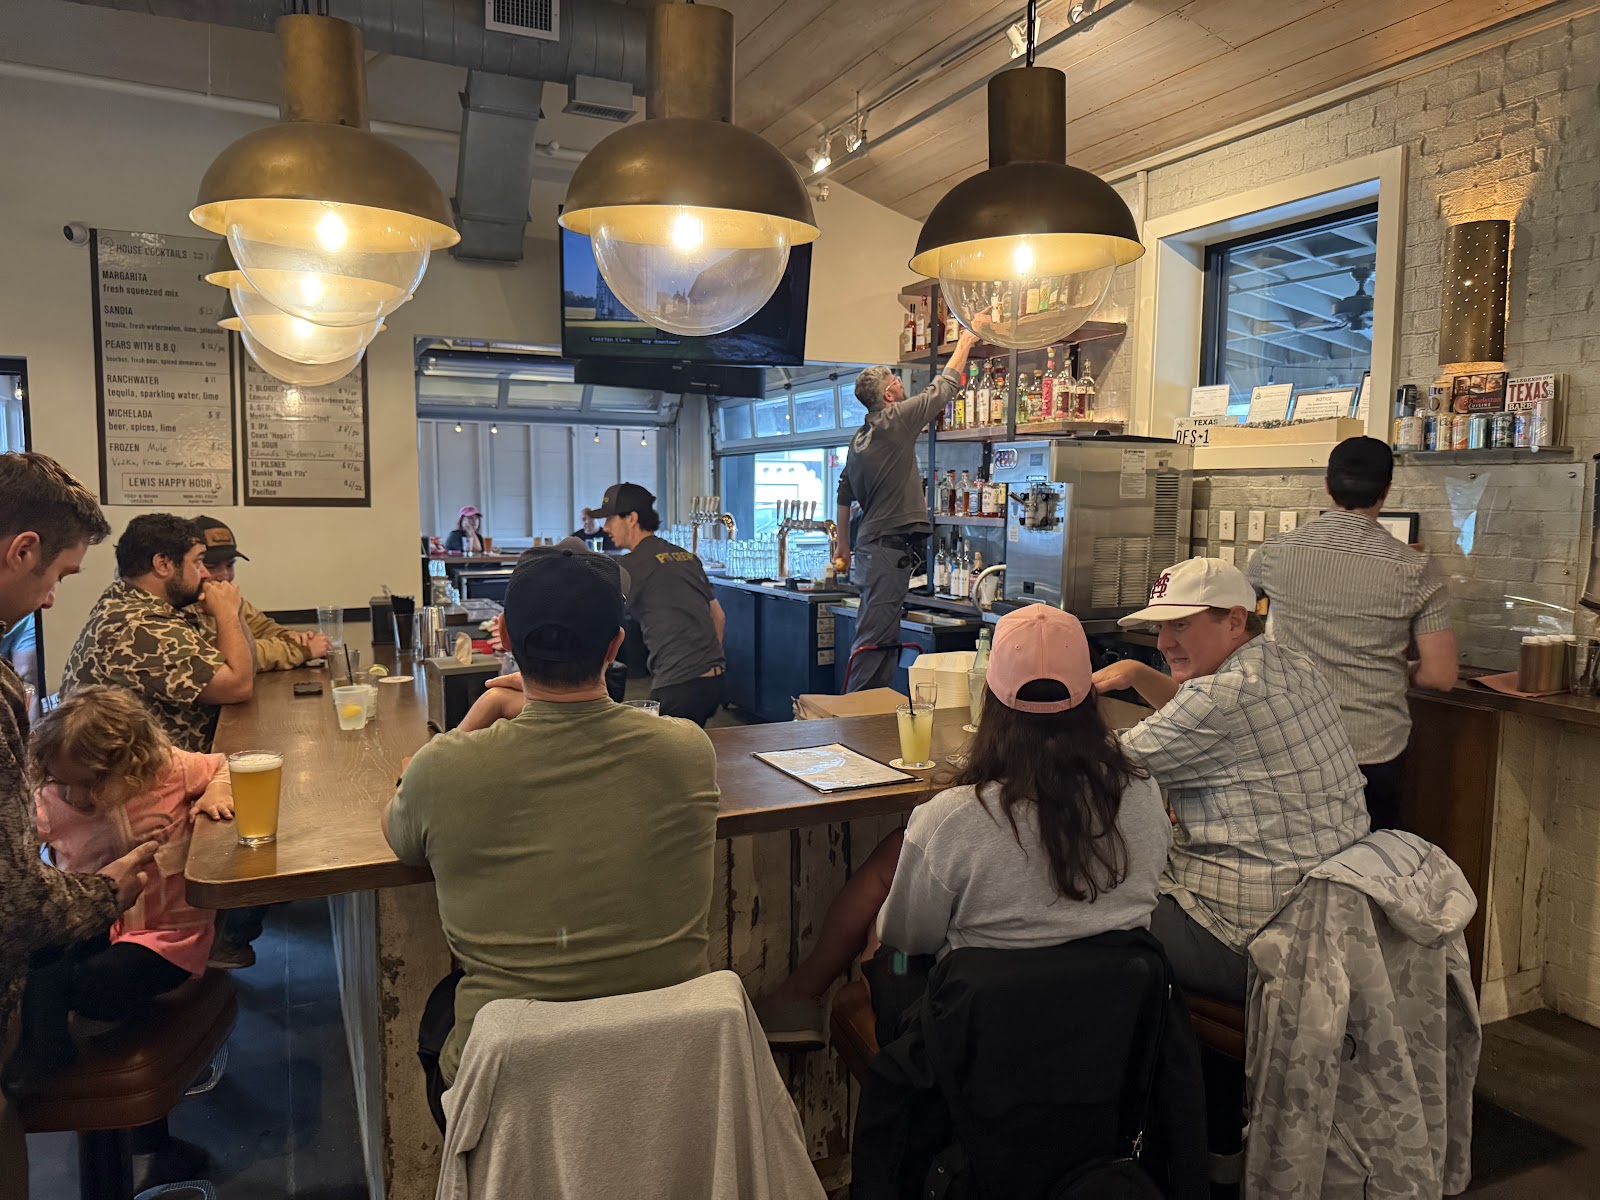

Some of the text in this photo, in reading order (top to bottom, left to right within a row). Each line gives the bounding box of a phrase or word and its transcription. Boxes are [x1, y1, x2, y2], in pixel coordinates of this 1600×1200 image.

[116, 244, 142, 255] HOUSE
[144, 247, 188, 259] COCKTAILS
[102, 270, 148, 282] MARGARITA
[103, 284, 179, 298] fresh squeezed mix
[104, 305, 133, 316] SANDIA
[129, 321, 146, 330] fresh
[105, 339, 132, 350] PEARS
[133, 340, 154, 351] WITH
[130, 356, 146, 364] fresh
[161, 358, 178, 366] spiced
[106, 374, 159, 385] RANCHWATER
[255, 384, 279, 393] BLONDE
[1508, 381, 1549, 403] TEXAS
[107, 388, 219, 401] tequila, sparkling water, lime
[1508, 402, 1533, 411] BARB
[108, 408, 153, 419] MICHELADA
[108, 421, 177, 433] beer, spices, lime
[258, 422, 269, 430] IPA
[250, 431, 269, 439] Coast
[109, 442, 140, 452] FROZEN
[147, 443, 168, 453] Mule
[261, 441, 278, 449] SOUR
[128, 477, 213, 488] LEWIS HAPPY HOUR
